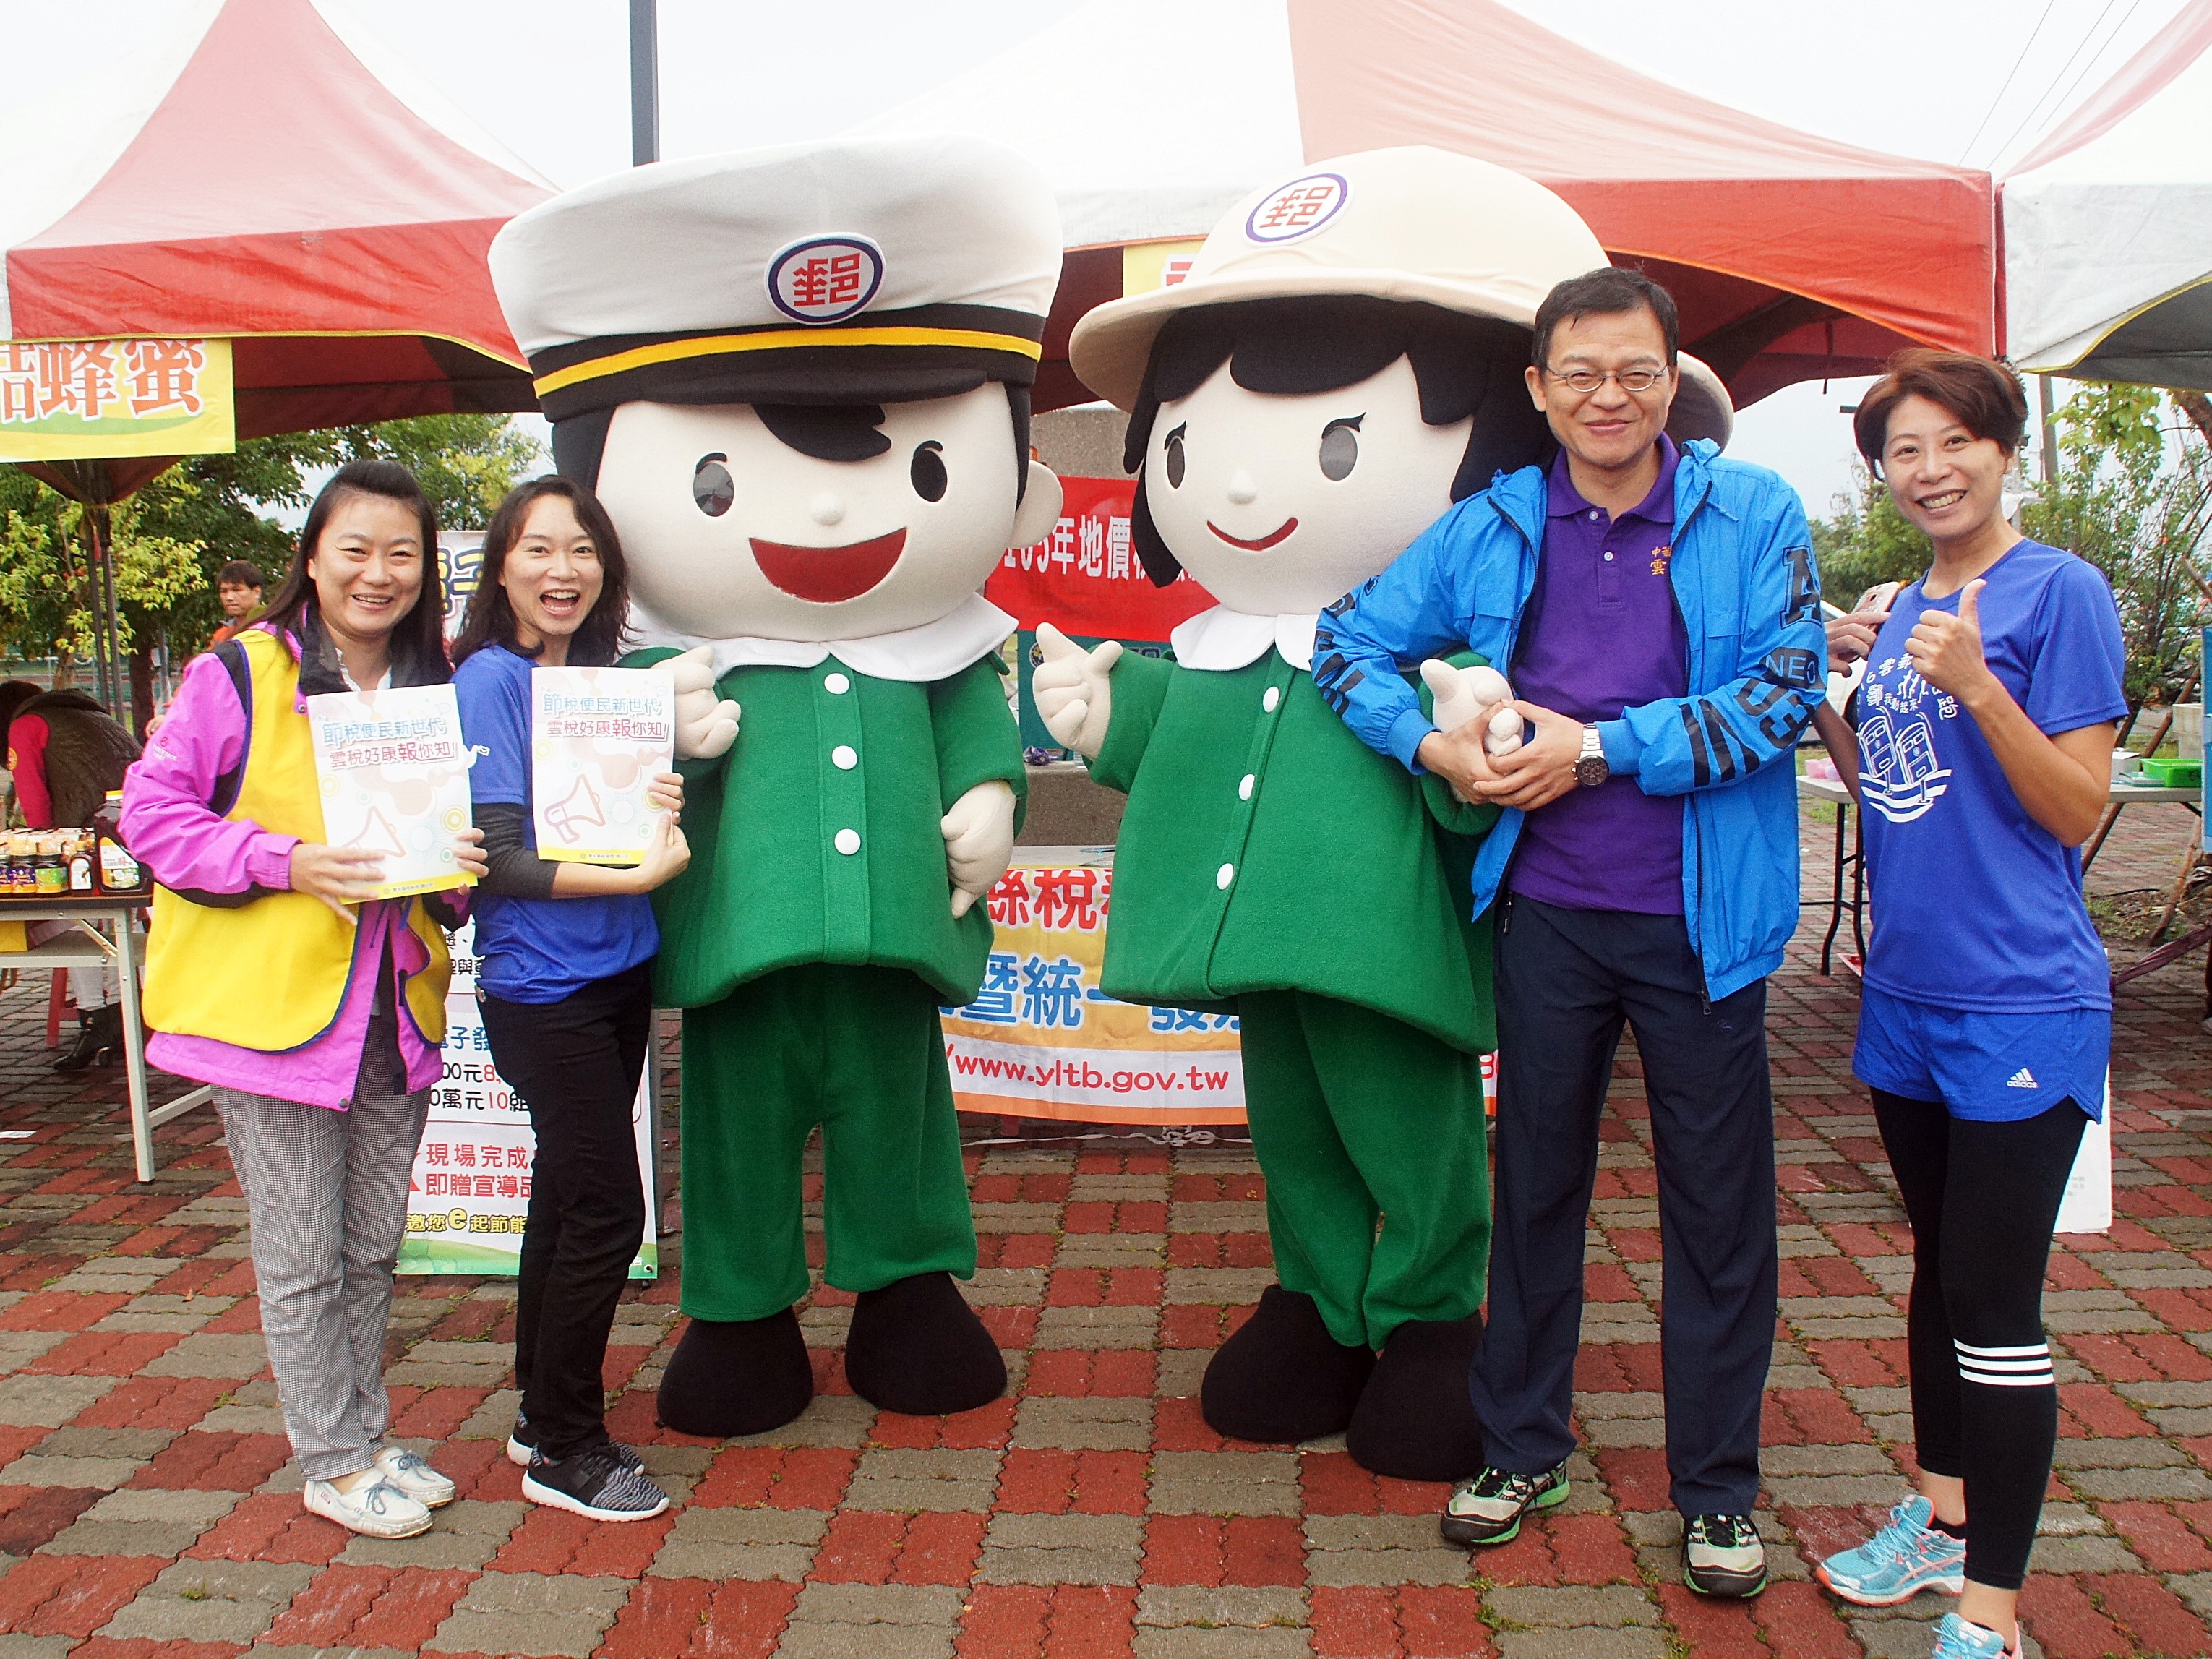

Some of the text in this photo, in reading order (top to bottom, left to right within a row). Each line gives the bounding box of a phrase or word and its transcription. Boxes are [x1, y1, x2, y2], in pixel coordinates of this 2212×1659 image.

[1259, 186, 1334, 228] 郵
[792, 252, 861, 306] 郵
[544, 693, 661, 716] 節稅便民新世代
[323, 717, 446, 745] 節稅便民新世代
[2006, 1080, 2039, 1089] adidas
[426, 1144, 537, 1170] 現場完成
